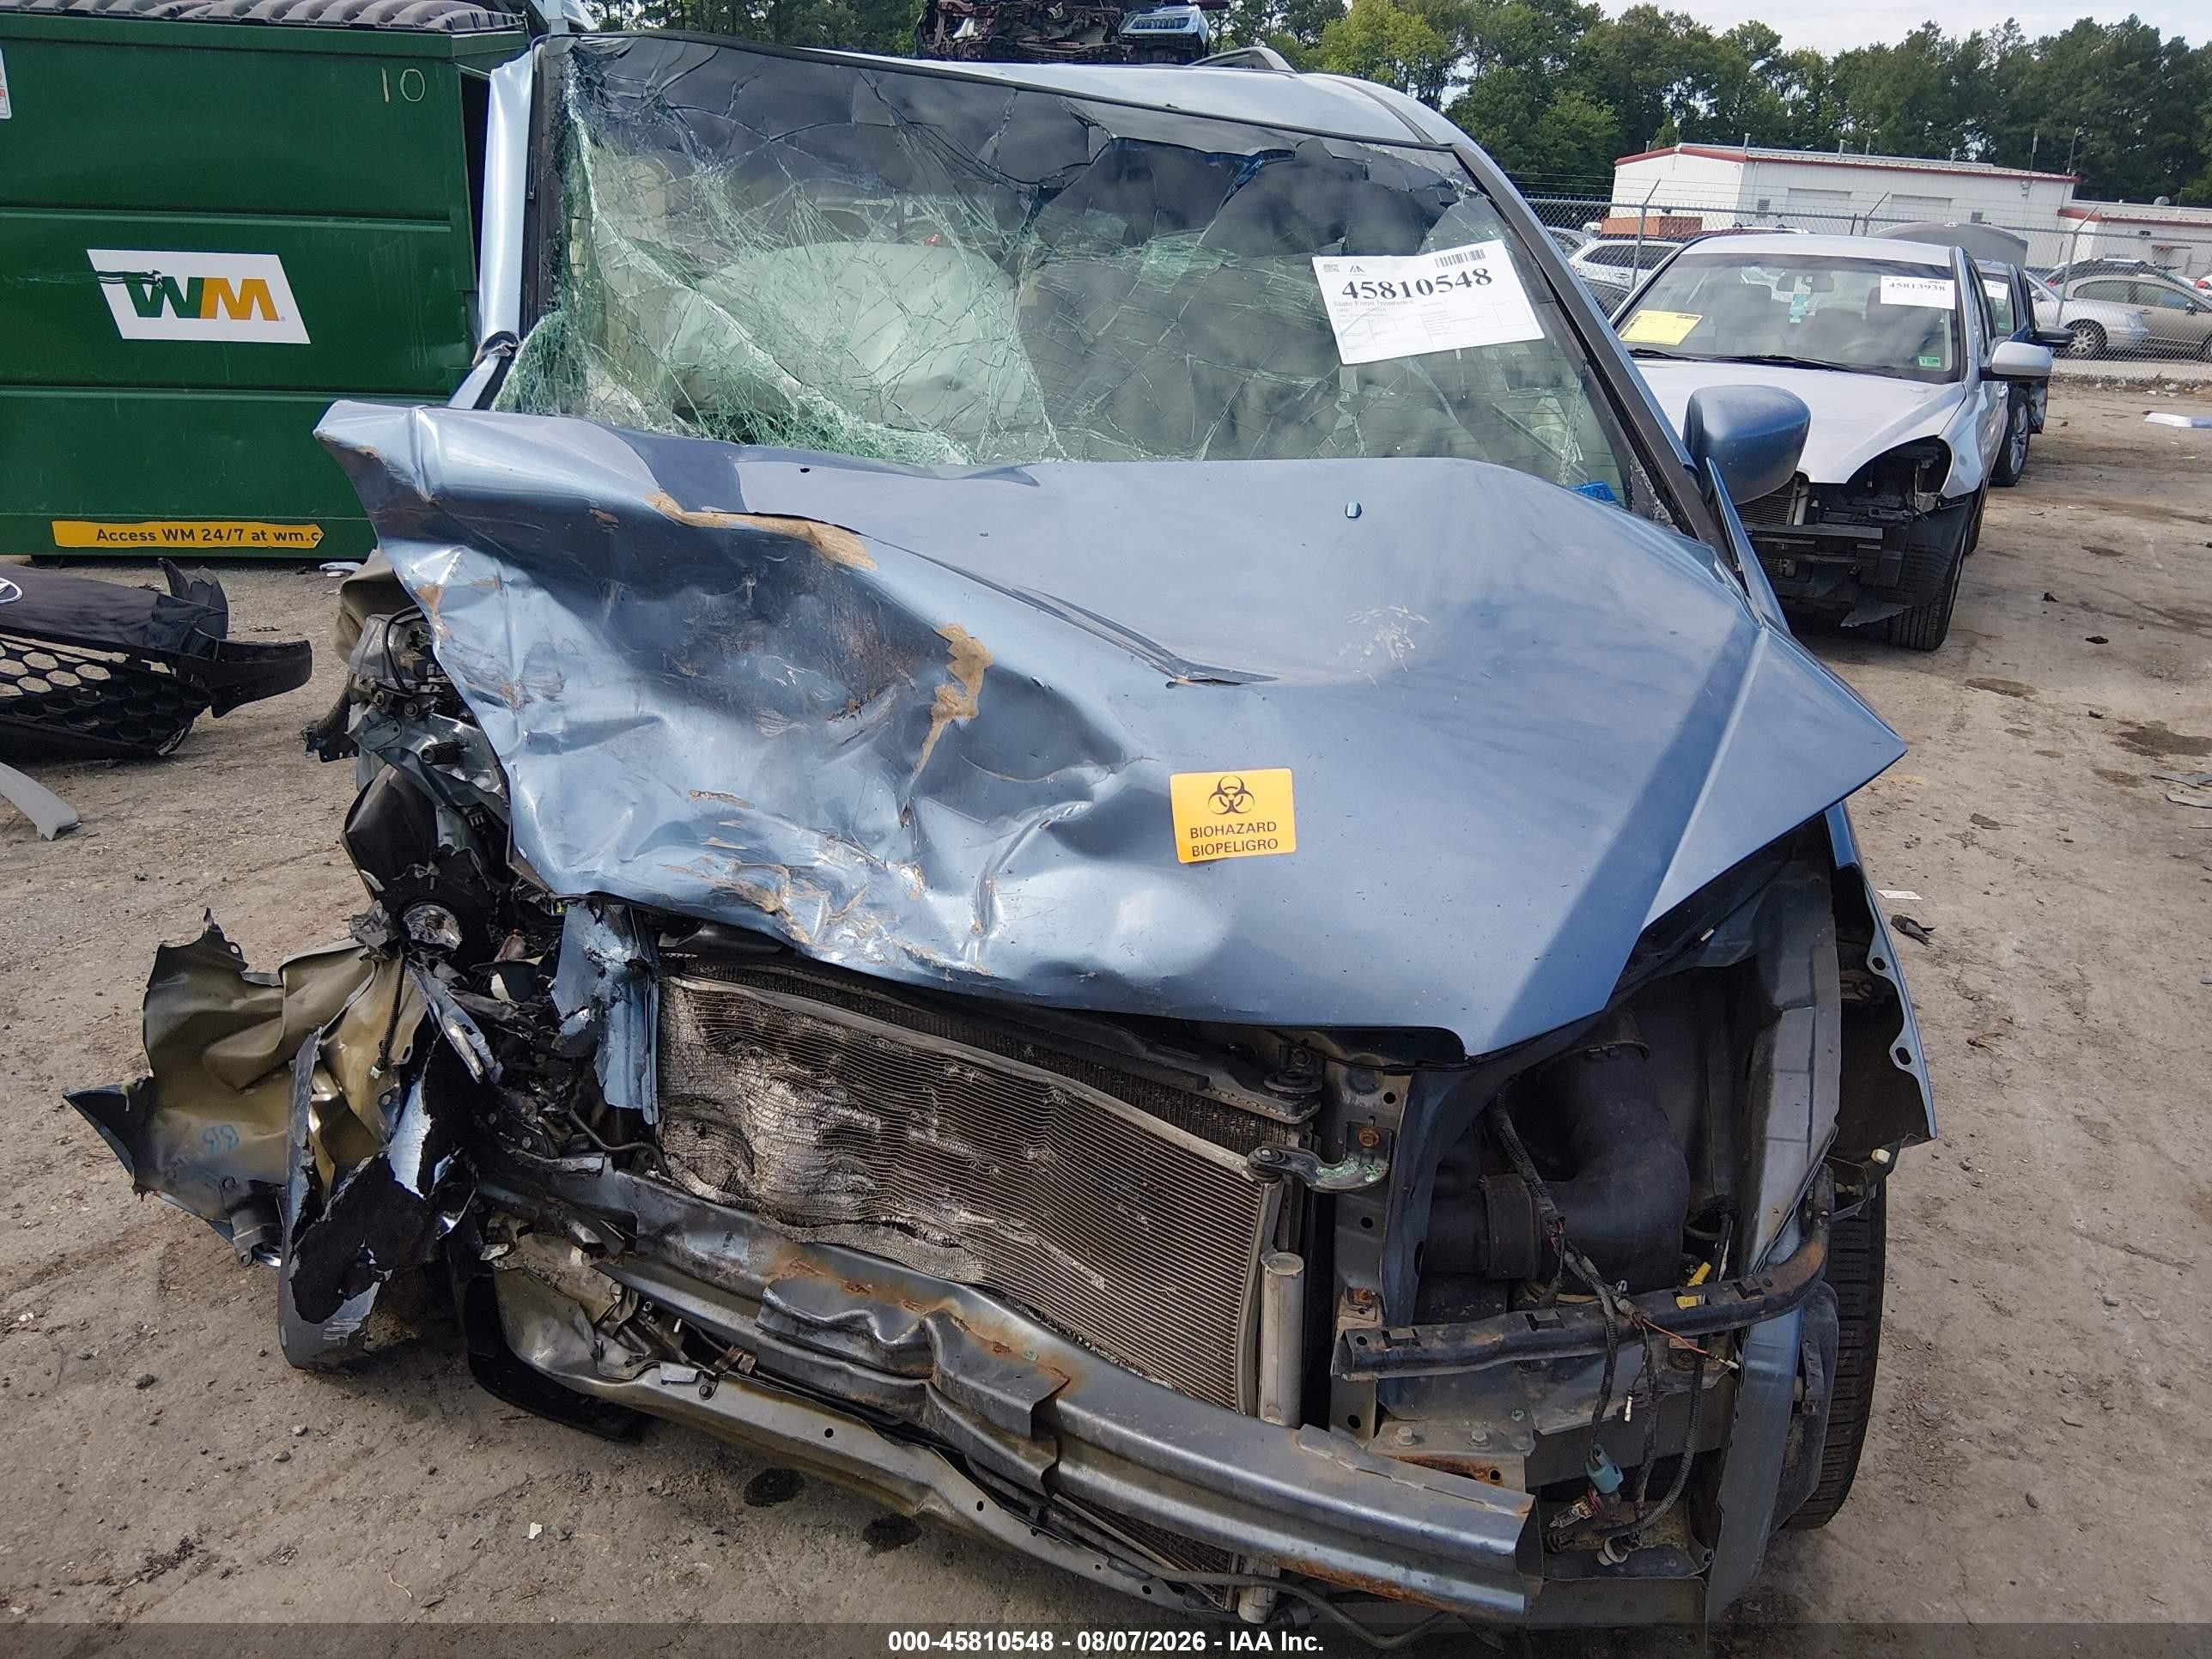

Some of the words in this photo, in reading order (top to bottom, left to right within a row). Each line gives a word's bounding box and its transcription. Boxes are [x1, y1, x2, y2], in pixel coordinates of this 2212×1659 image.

[381, 66, 426, 103] 10
[1342, 268, 1492, 300] 45810548
[124, 276, 280, 322] WM
[96, 528, 157, 543] Access
[161, 528, 196, 542] WM
[202, 528, 245, 542] 24/7
[252, 529, 268, 542] at
[1190, 822, 1277, 839] BIOHAZARD
[1192, 838, 1279, 857] BIOPELIGRO
